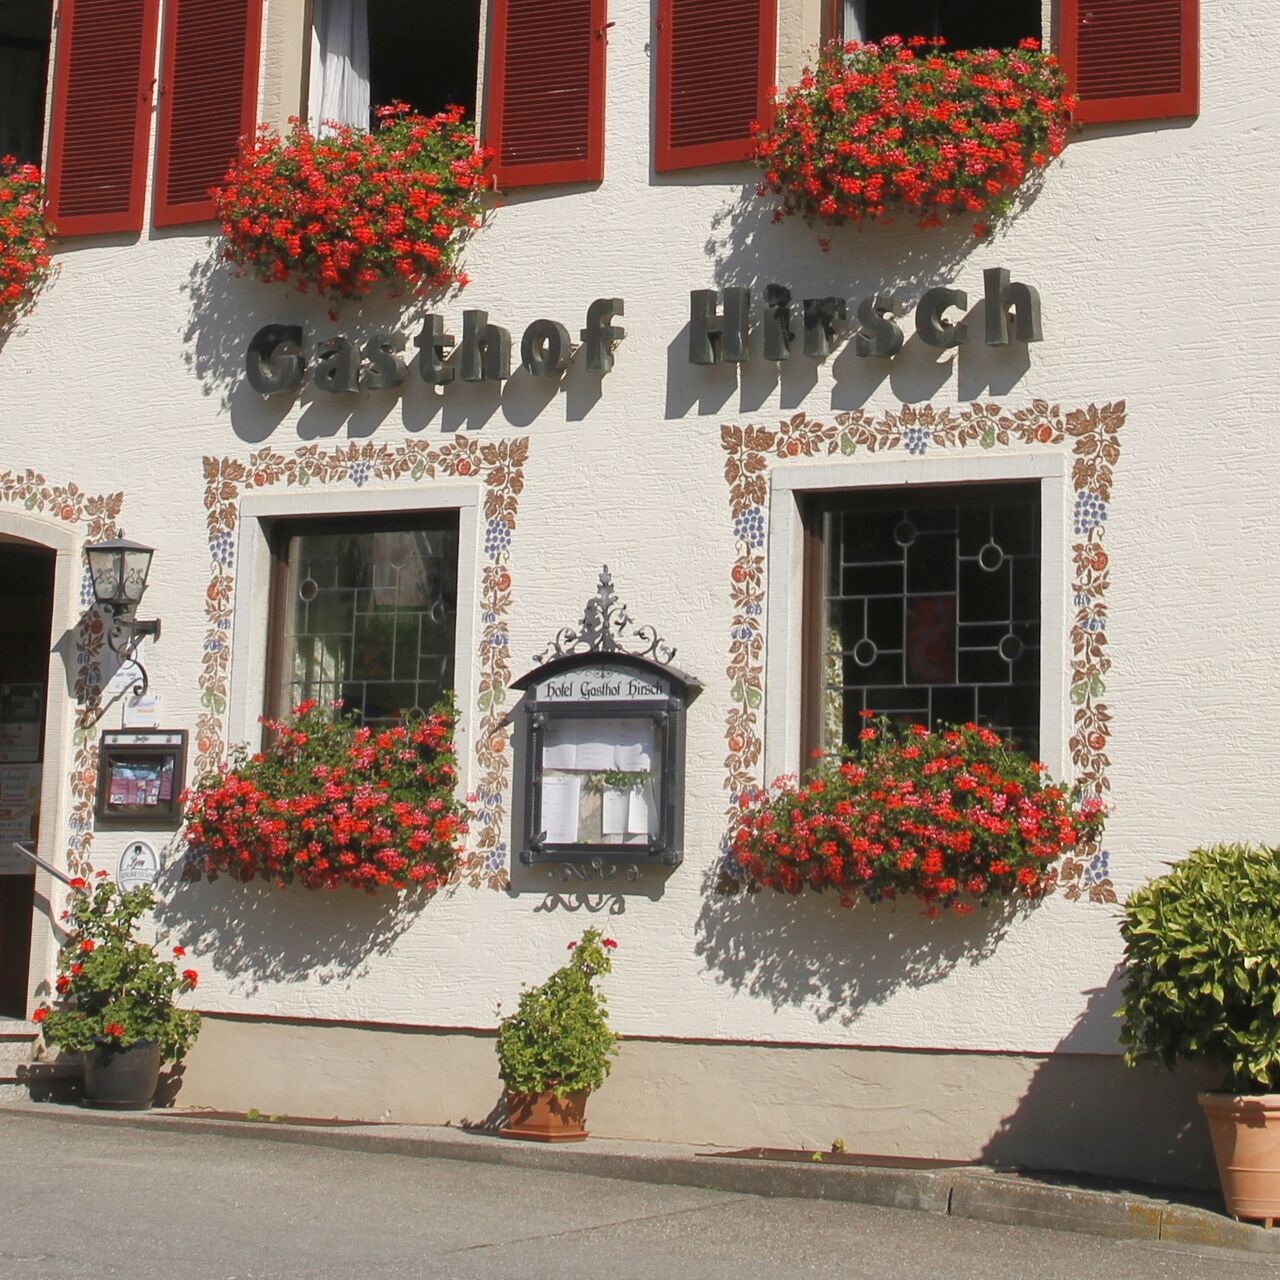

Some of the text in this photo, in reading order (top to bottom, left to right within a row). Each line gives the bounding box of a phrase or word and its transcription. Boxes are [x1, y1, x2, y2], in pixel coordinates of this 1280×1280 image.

[245, 267, 1043, 395] Gasthof Hirsch
[580, 680, 621, 700] Gasthof
